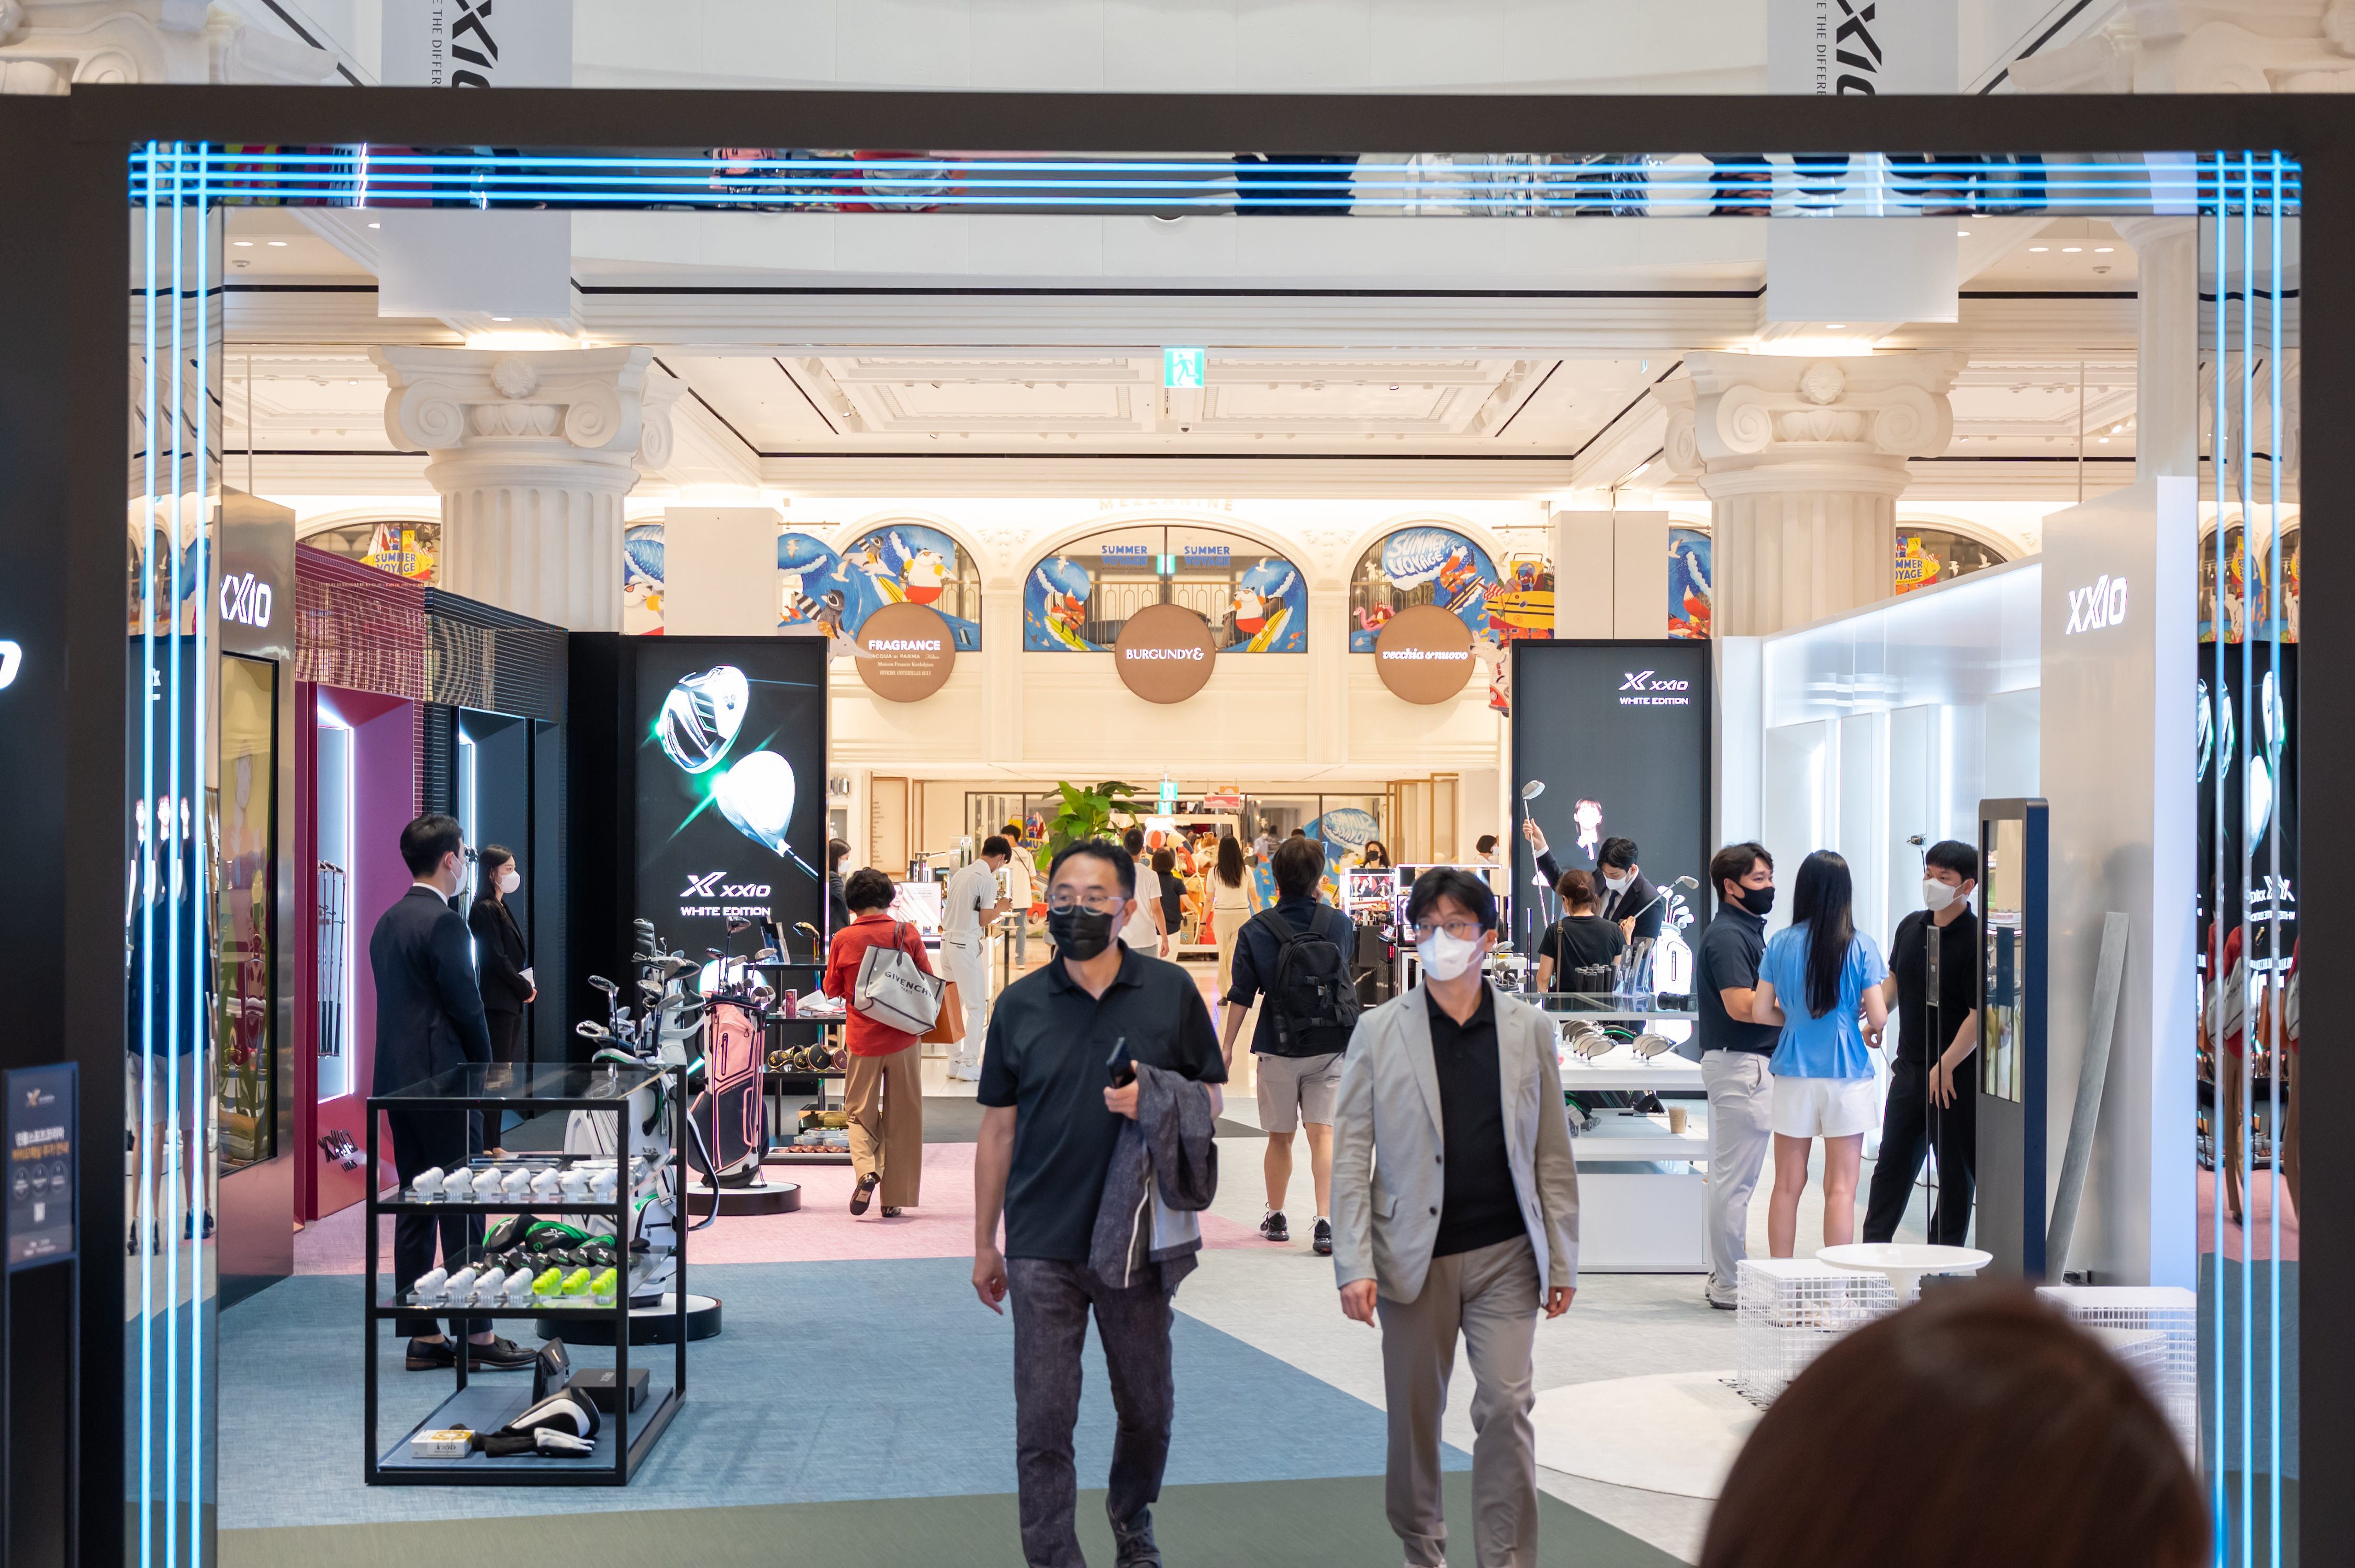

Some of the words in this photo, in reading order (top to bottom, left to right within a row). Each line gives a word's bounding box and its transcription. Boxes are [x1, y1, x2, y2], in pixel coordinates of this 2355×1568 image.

[432, 9, 442, 35] THE
[1816, 14, 1826, 39] THE
[432, 40, 442, 88] DIFFER
[1102, 545, 1148, 554] SUMMER
[1184, 546, 1230, 555] SUMMER
[1387, 533, 1450, 558] SUMMER
[1102, 556, 1148, 566] VOYAGE
[1184, 556, 1230, 566] VOYAGE
[1388, 550, 1444, 576] VOYAGE
[2065, 574, 2127, 635] XXIO
[869, 640, 940, 650] FRAGRANCE
[1126, 647, 1204, 661] BURGUNDY&
[1383, 648, 1424, 660] vecchia
[1434, 652, 1468, 660] nuovo
[1649, 680, 1689, 691] XXIO
[720, 884, 771, 897] XXIO
[680, 907, 721, 916] WHITE
[723, 907, 771, 916] EDITION
[884, 971, 932, 998] GIVENCHY
[901, 986, 913, 995] PARIS
